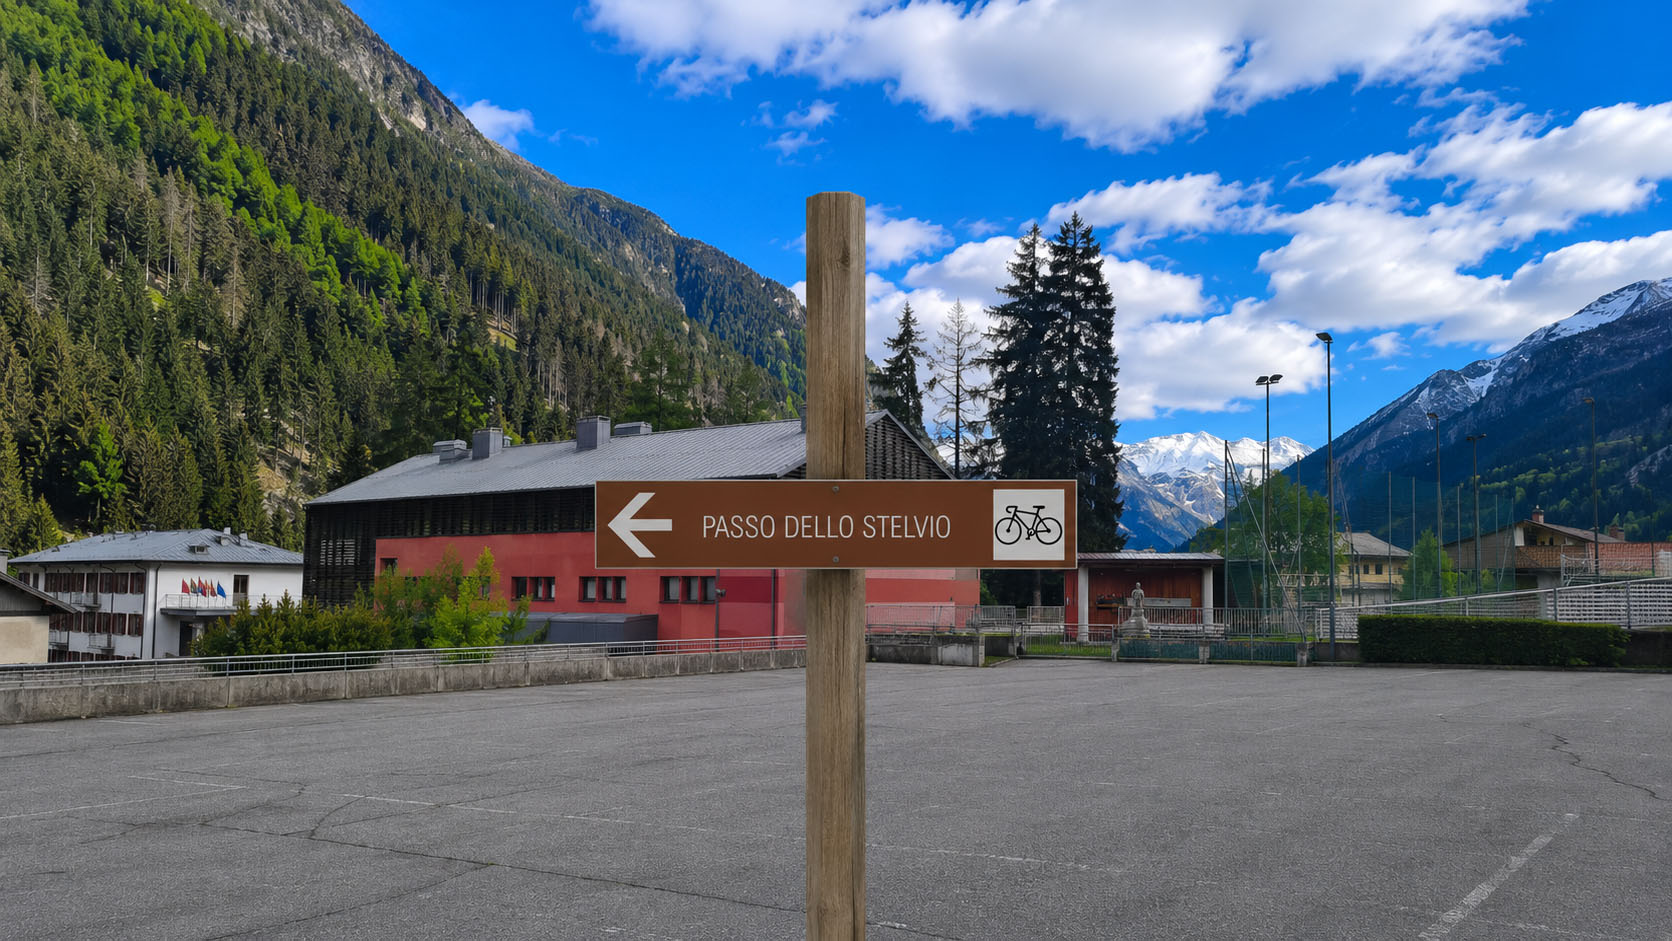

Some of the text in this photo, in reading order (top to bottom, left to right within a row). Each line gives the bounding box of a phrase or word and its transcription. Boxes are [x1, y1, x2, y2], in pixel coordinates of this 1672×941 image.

[703, 514, 951, 539] PASSO DELLO STELVIO
